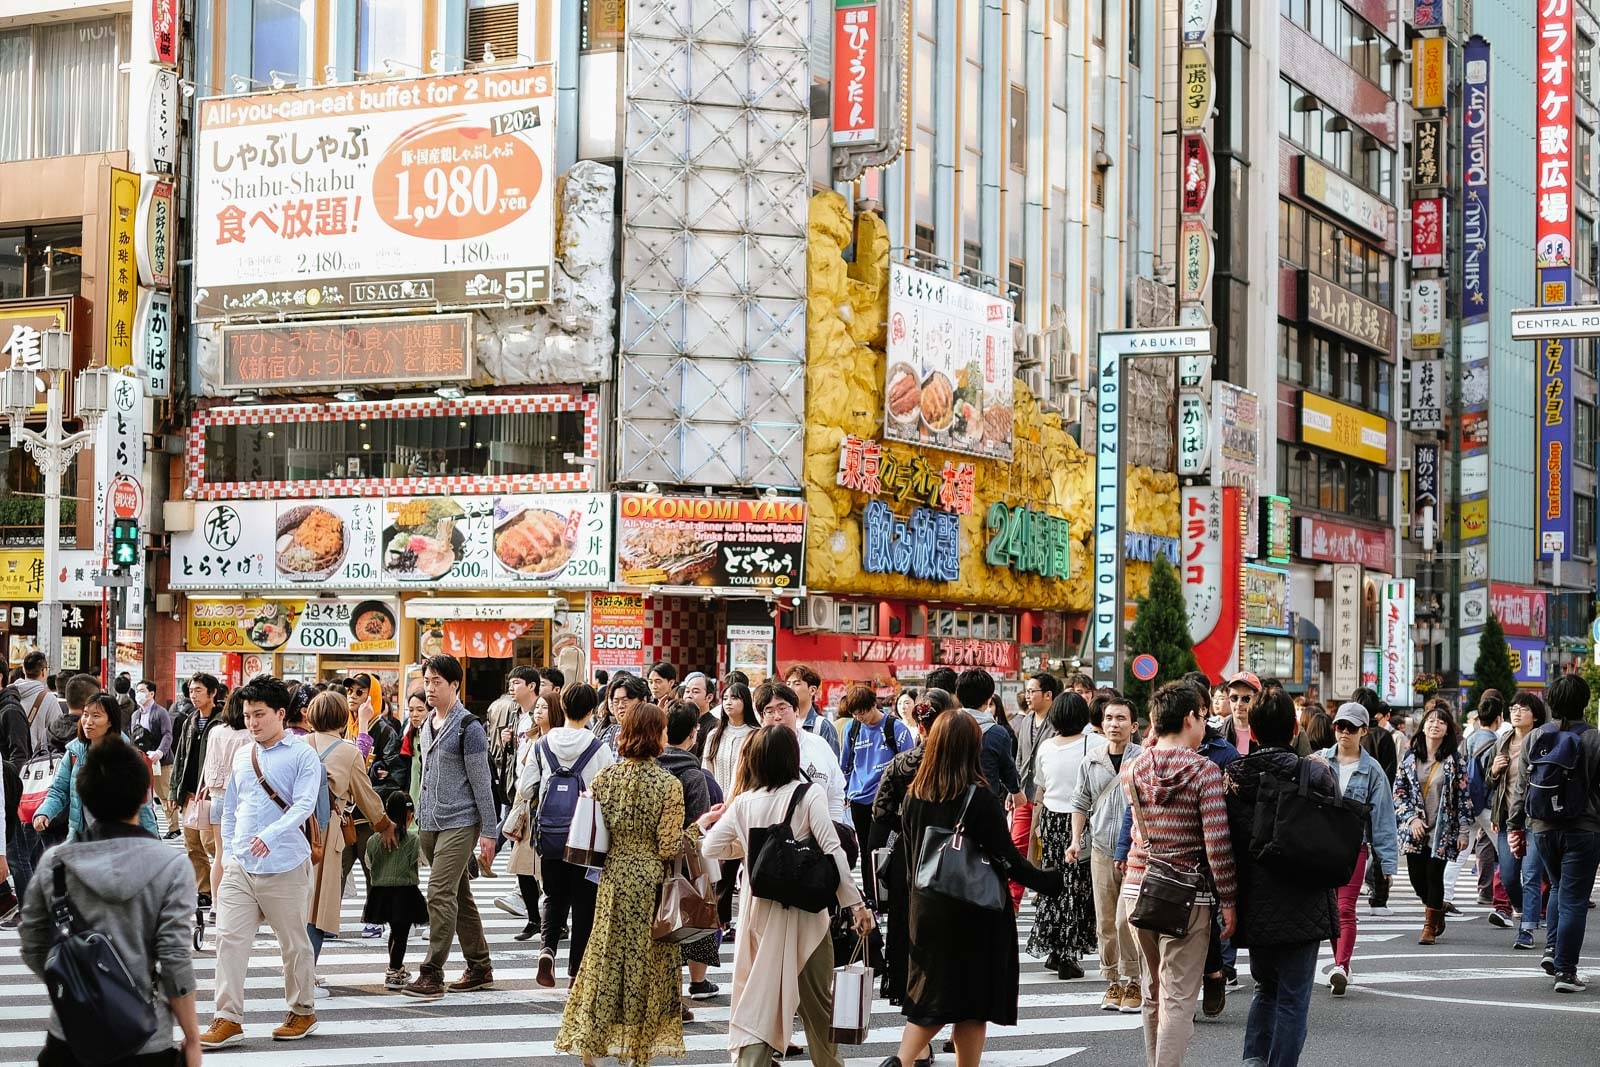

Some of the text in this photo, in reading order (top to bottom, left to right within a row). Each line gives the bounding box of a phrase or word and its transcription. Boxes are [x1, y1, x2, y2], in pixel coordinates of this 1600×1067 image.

[845, 11, 869, 24] 新宿
[843, 24, 869, 128] ひょうたん
[1186, 69, 1207, 109] 虎の子
[206, 75, 548, 127] All-you-can-eat buffet for 2 hours
[1540, 0, 1569, 223] カラオケ歌広場
[157, 92, 169, 158] とらそば
[492, 110, 538, 136] 120分
[849, 131, 863, 141] 7F
[212, 125, 372, 173] しゃぶしゃぶ
[1418, 121, 1437, 177] 山内農場
[393, 163, 529, 227] 1,980 yen
[215, 195, 362, 245] 食べ放題!
[154, 200, 168, 275] お好み焼き
[441, 240, 490, 265] 1,480
[1465, 202, 1486, 290] SHINJUKU
[297, 249, 343, 275] 2,480
[504, 269, 546, 300] 5F
[907, 274, 946, 304] とらそば
[1311, 284, 1320, 310] 5F
[1320, 285, 1380, 345] 山内農場
[1517, 317, 1577, 329] CENTRAL
[113, 319, 129, 348] 集
[150, 312, 168, 372] かっぱ
[1130, 336, 1196, 348] KABUKI町
[114, 380, 135, 411] 虎
[151, 377, 165, 390] B1
[1182, 408, 1200, 453] かっぱ
[836, 432, 977, 517] 東京カラオケ本舗
[1184, 459, 1198, 468] B1
[1418, 447, 1434, 492] 海の家
[114, 492, 137, 511] 消火栓
[351, 503, 363, 531] そば
[623, 497, 804, 522] OKONOMI YAKI
[1097, 383, 1117, 625] GODZILLA ROAD
[1207, 490, 1222, 543] 大衆酒場
[207, 504, 237, 548] 虎
[363, 501, 377, 558] かき揚げ
[463, 501, 476, 559] ラーメン
[478, 500, 490, 560] とんこつ
[587, 496, 604, 556] かつ丼
[623, 520, 803, 534] All-You-Can-Eat dinner with Free-Flowing
[693, 532, 803, 544] Drinks for 2 hours ¥2,500
[863, 498, 962, 583] 飲み放題
[986, 500, 1071, 581] 24時間
[1186, 496, 1207, 585] トラノコ
[183, 553, 256, 577] とらそば
[342, 562, 378, 580] 450円
[451, 561, 489, 579] 500円
[567, 558, 607, 577] 520円
[723, 545, 793, 574] とらぢゅう
[728, 576, 789, 586] TORADYU 2F
[193, 602, 279, 619] とんこつラーメン
[593, 595, 643, 608] お好み焼き
[299, 627, 347, 648] 680円
[593, 633, 643, 651] 2,500円
